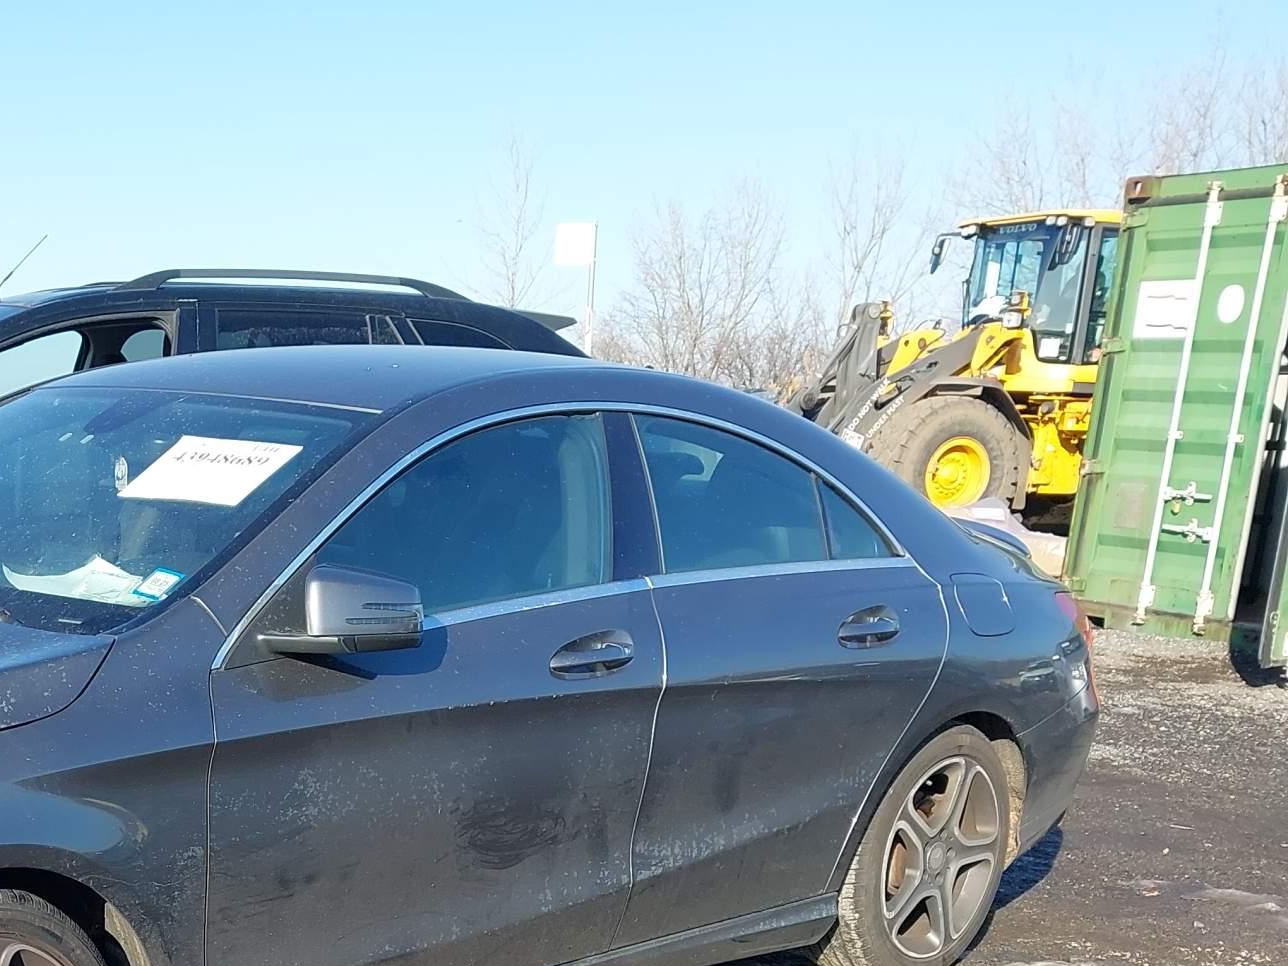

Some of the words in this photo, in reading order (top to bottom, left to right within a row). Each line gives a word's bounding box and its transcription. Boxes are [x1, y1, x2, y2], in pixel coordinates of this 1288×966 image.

[848, 417, 860, 431] DO
[857, 399, 873, 419] NOT
[865, 414, 889, 439] UNDER
[886, 395, 905, 415] MAST
